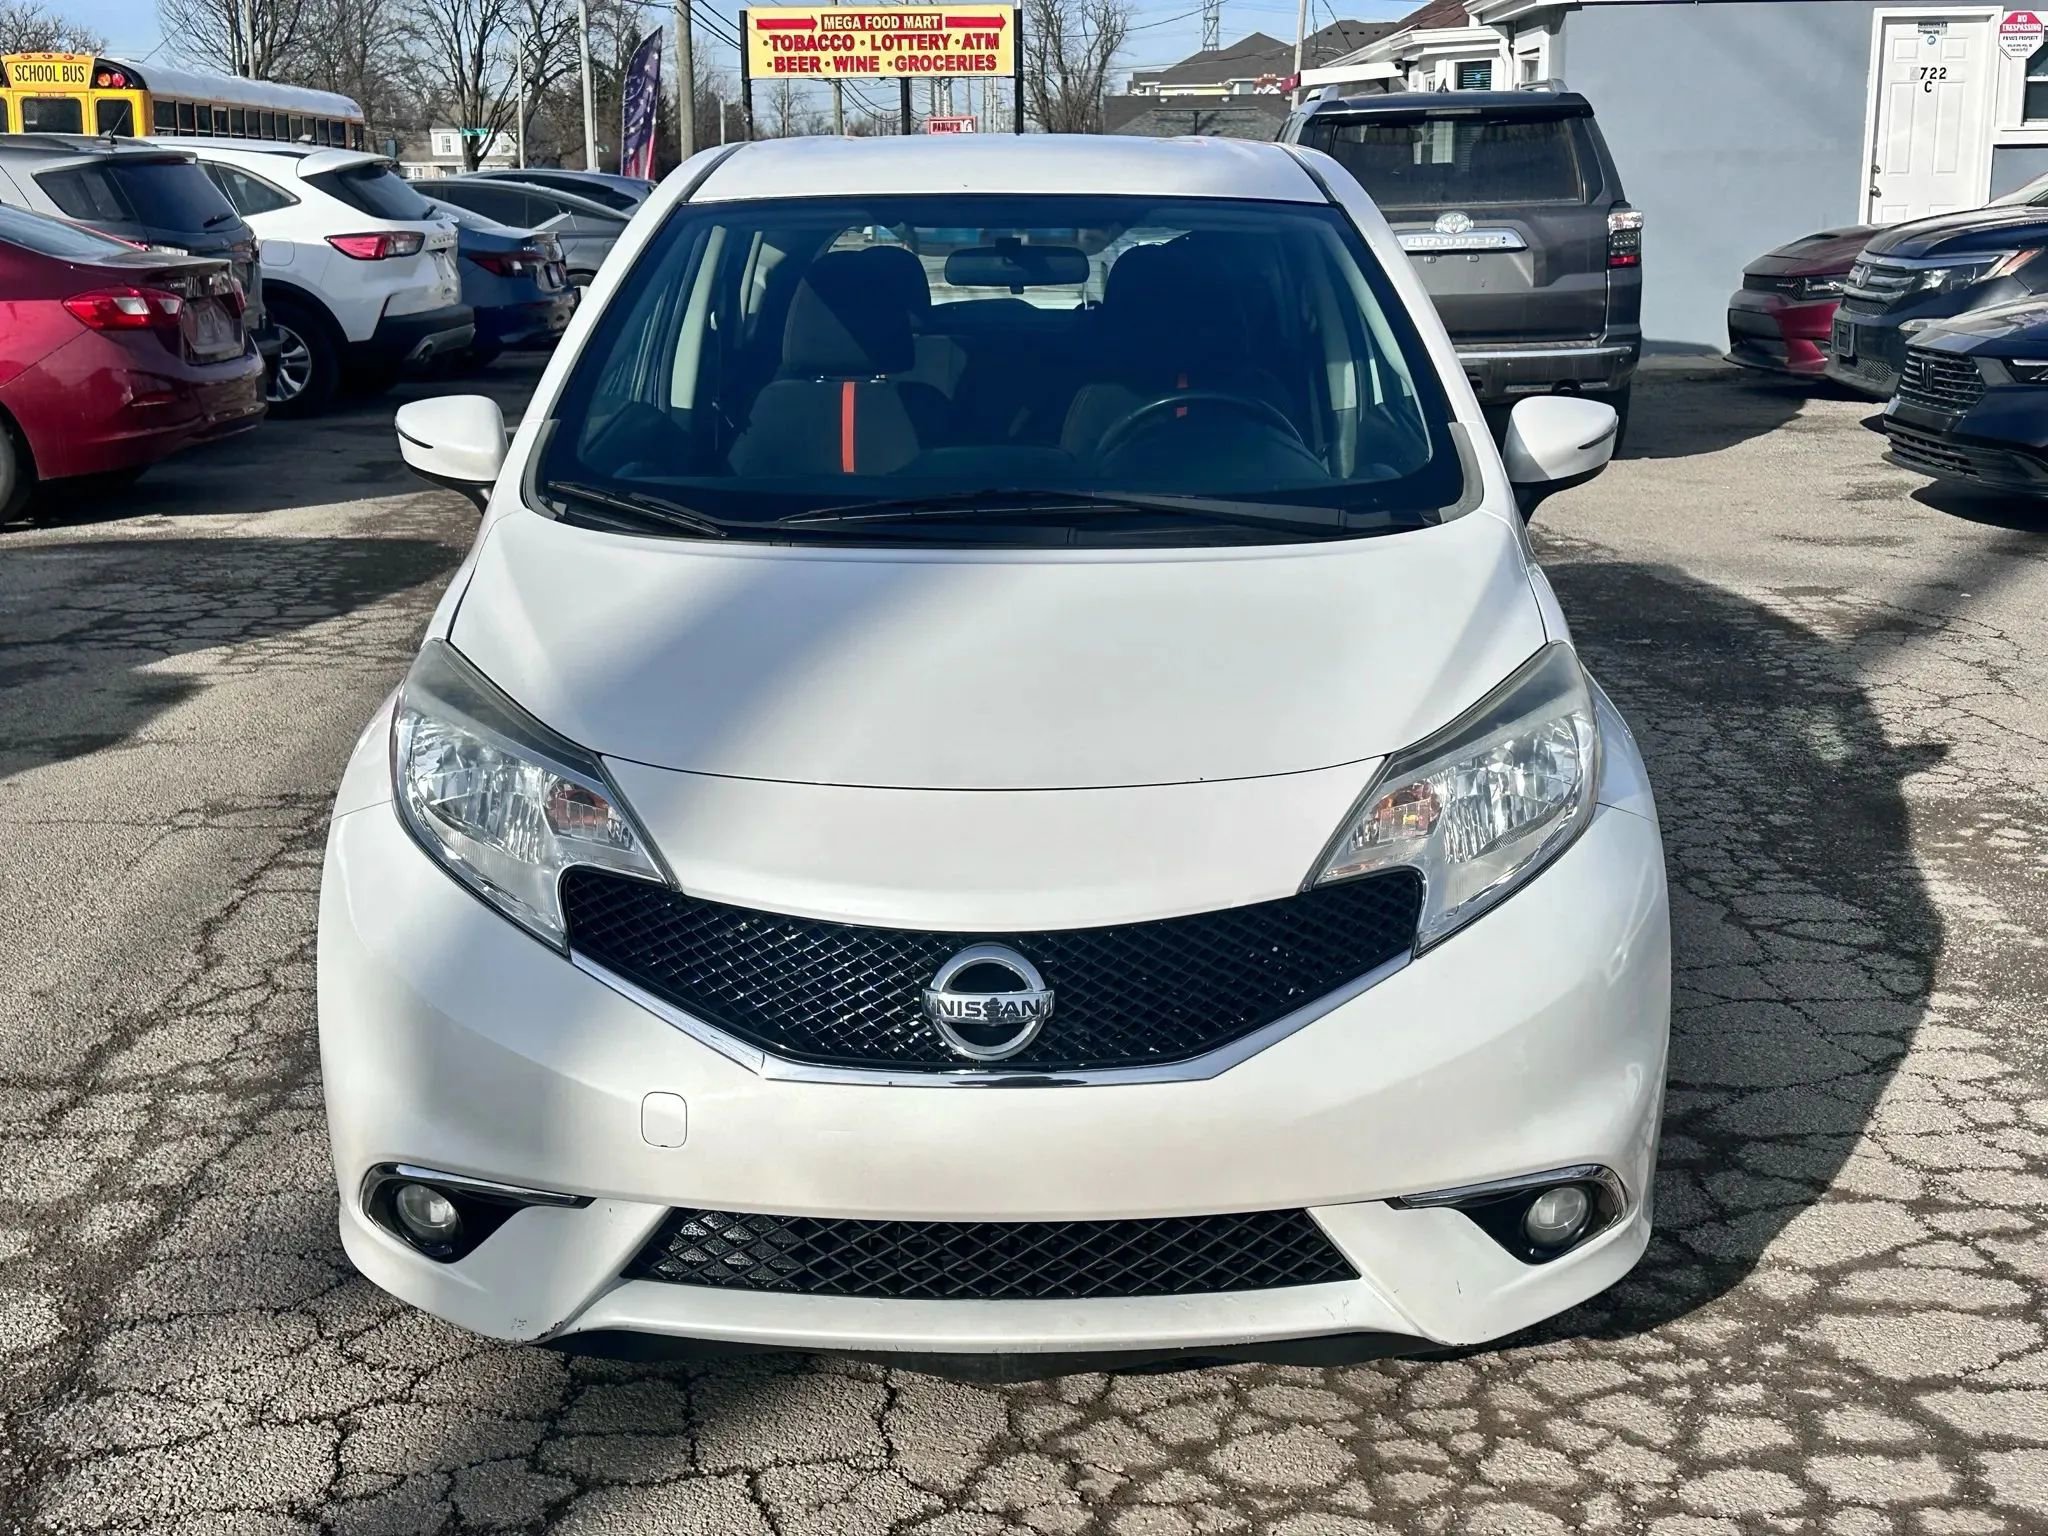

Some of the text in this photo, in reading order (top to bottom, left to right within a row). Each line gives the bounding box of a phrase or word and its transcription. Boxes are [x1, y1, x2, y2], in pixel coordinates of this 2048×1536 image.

[823, 15, 940, 30] MEGA FOOD MART
[2017, 14, 2028, 22] NO
[769, 33, 1000, 52] TOBACCO LOTTERY ATM
[774, 54, 997, 73] BEER WINE GROCERIES
[14, 64, 85, 83] SCHOOL BUS
[1920, 67, 1947, 80] 722
[1924, 80, 1933, 93] C
[936, 998, 1040, 1018] NISSAN
